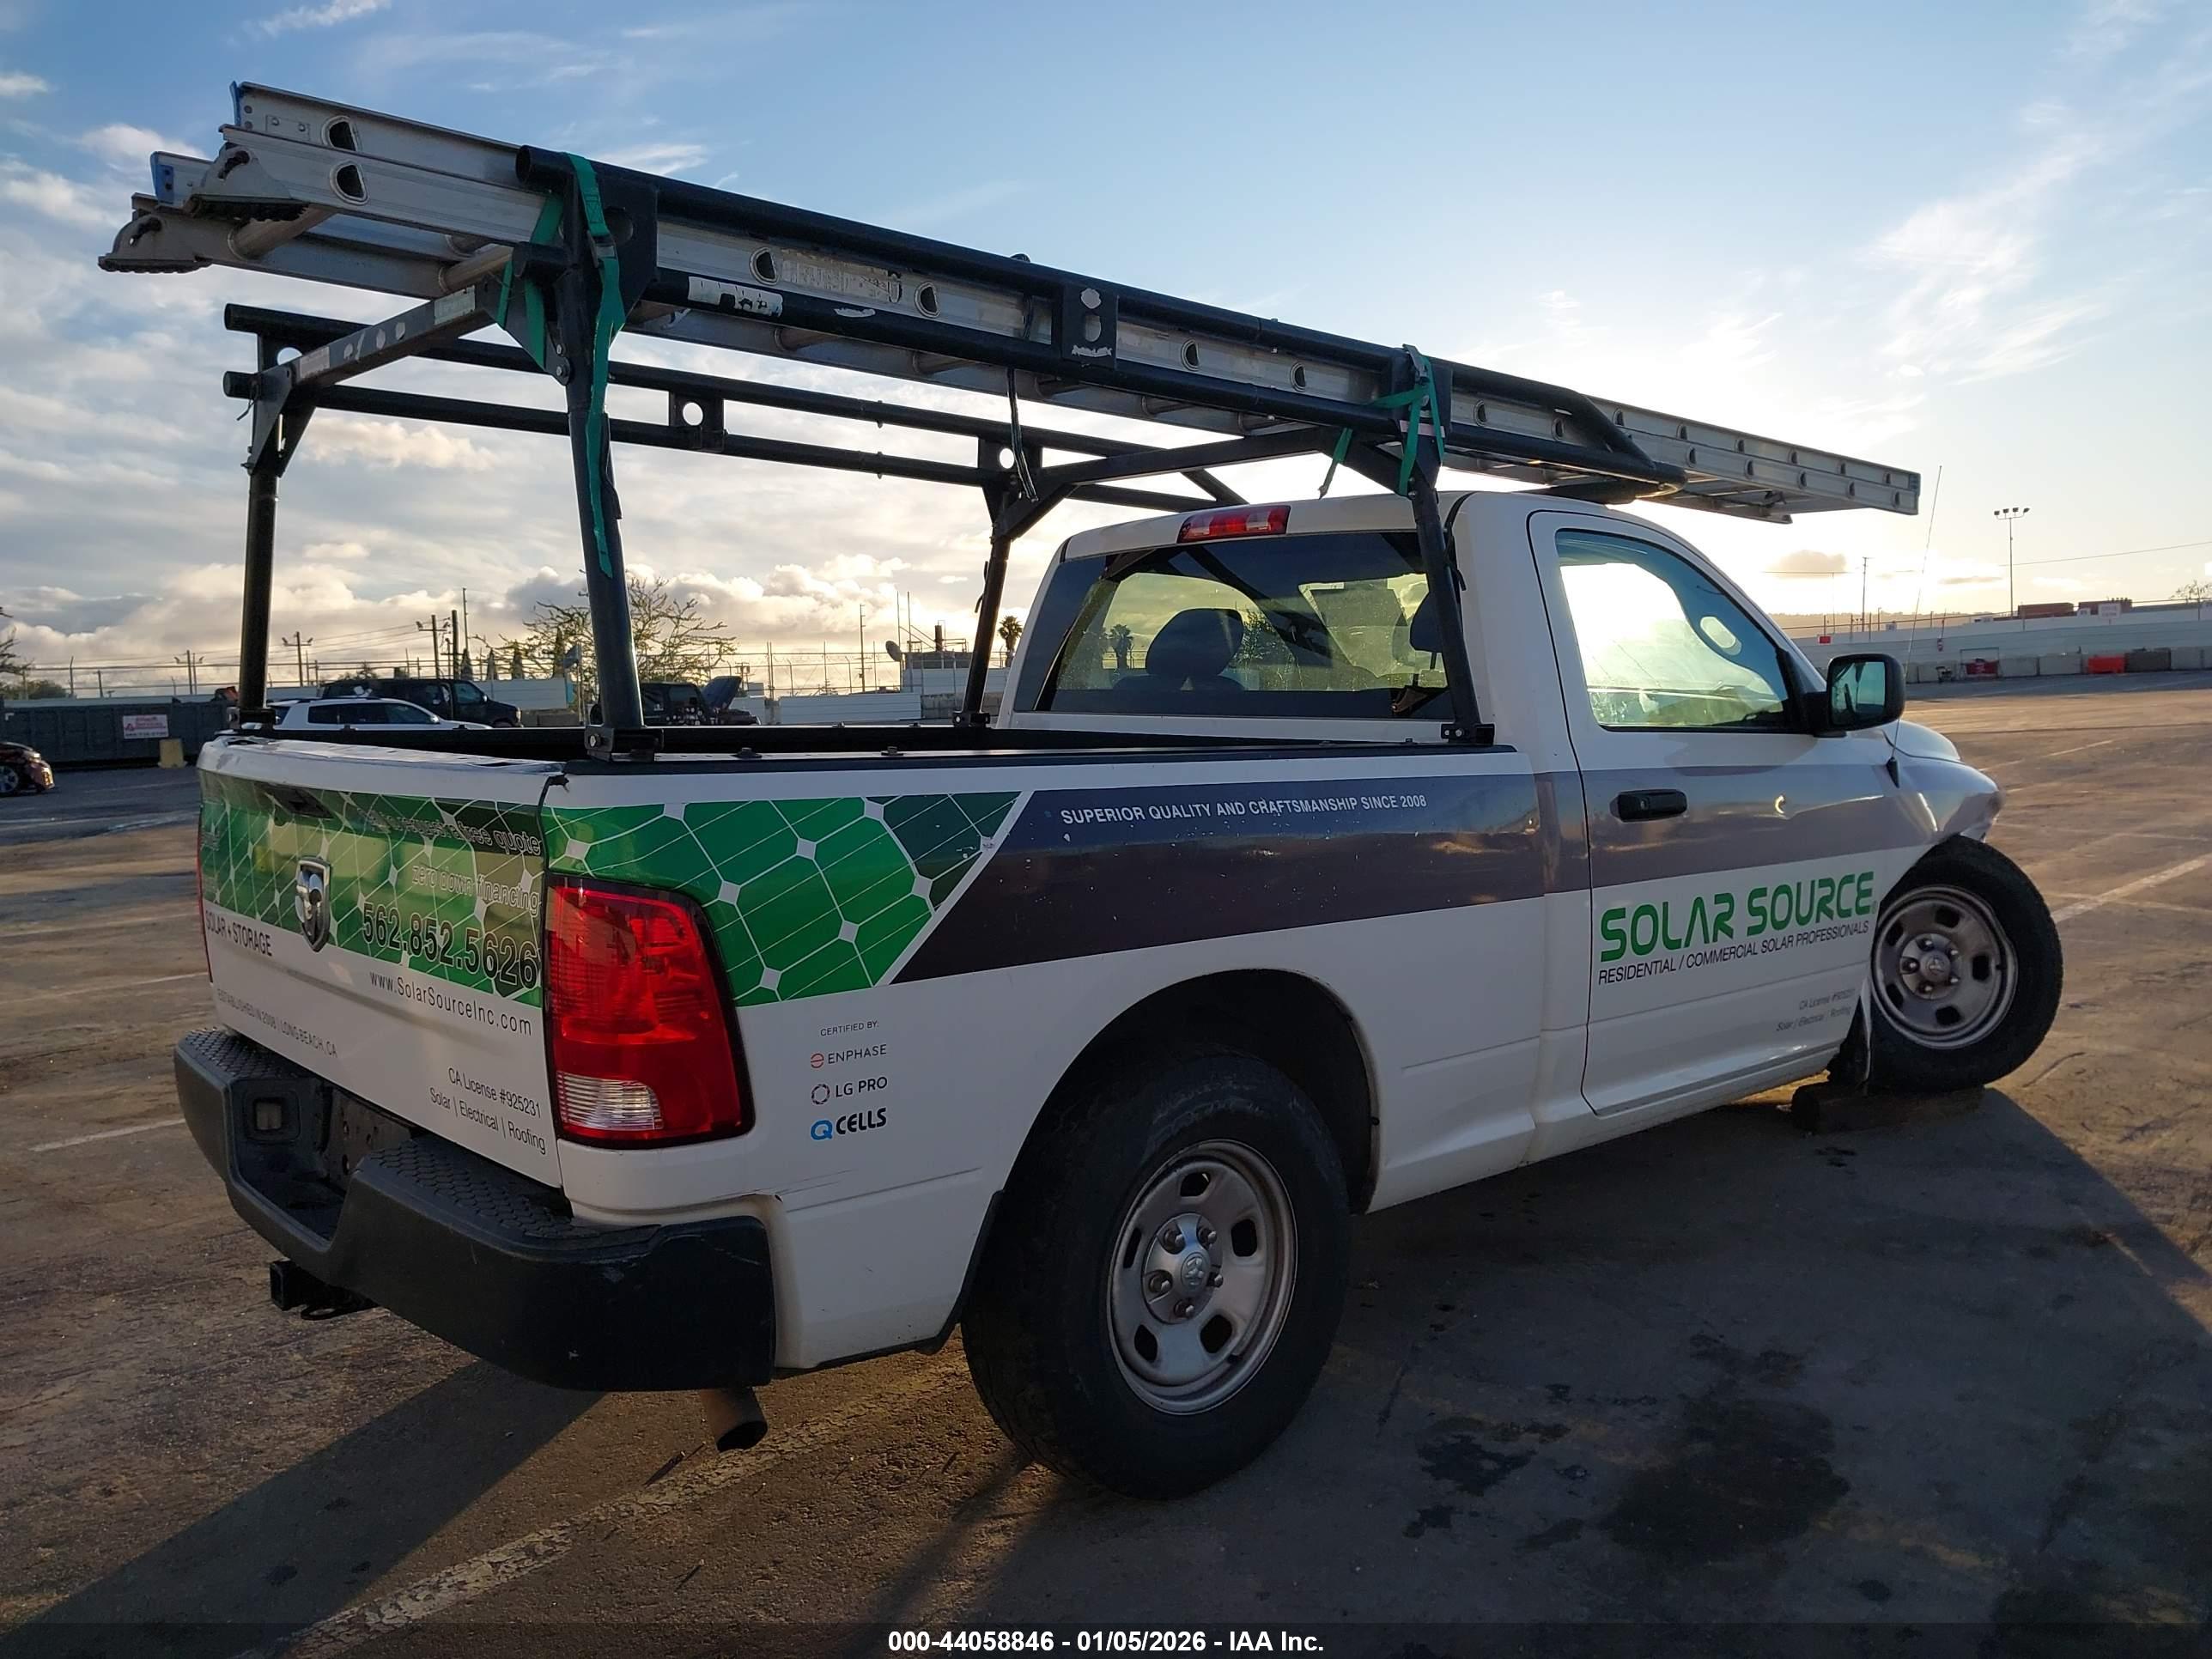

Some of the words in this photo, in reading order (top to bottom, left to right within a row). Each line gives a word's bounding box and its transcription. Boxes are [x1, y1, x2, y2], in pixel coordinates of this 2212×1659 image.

[1060, 806, 1146, 824] SUPERIOR
[1148, 803, 1212, 820] QUALITY
[1216, 801, 1245, 816] AND
[1249, 797, 1358, 815] CRAFTSMANSHIP
[1360, 795, 1398, 810] SINCE
[1400, 794, 1427, 808] 2008
[493, 830, 542, 855] quote
[412, 865, 438, 887] zero
[440, 867, 473, 896] down
[477, 873, 540, 917] financing
[205, 910, 226, 936] SOLAR
[233, 921, 272, 957] STORAGE
[1600, 892, 1735, 963] SOLAR
[1747, 871, 1875, 937] SOURCE
[362, 902, 540, 988] 562.852.5626
[1598, 957, 1677, 986] RESIDENTIAL
[1686, 943, 1759, 969] COMMERCIAL
[1759, 935, 1795, 954] SOLAR
[1796, 921, 1869, 948] PROFESSIONALS
[369, 971, 532, 1036] www.SolarSourceInc.com
[820, 1023, 865, 1036] CERTIFIED
[867, 1020, 879, 1030] BY:
[828, 1044, 887, 1064] ENPHASE
[448, 1067, 463, 1087] CA
[463, 1073, 497, 1101] License
[500, 1088, 541, 1118] #925231
[836, 1083, 854, 1097] LG
[859, 1076, 888, 1093] PRO
[429, 1087, 451, 1109] Solar
[459, 1100, 499, 1132] Electrical
[507, 1121, 546, 1155] Roofing
